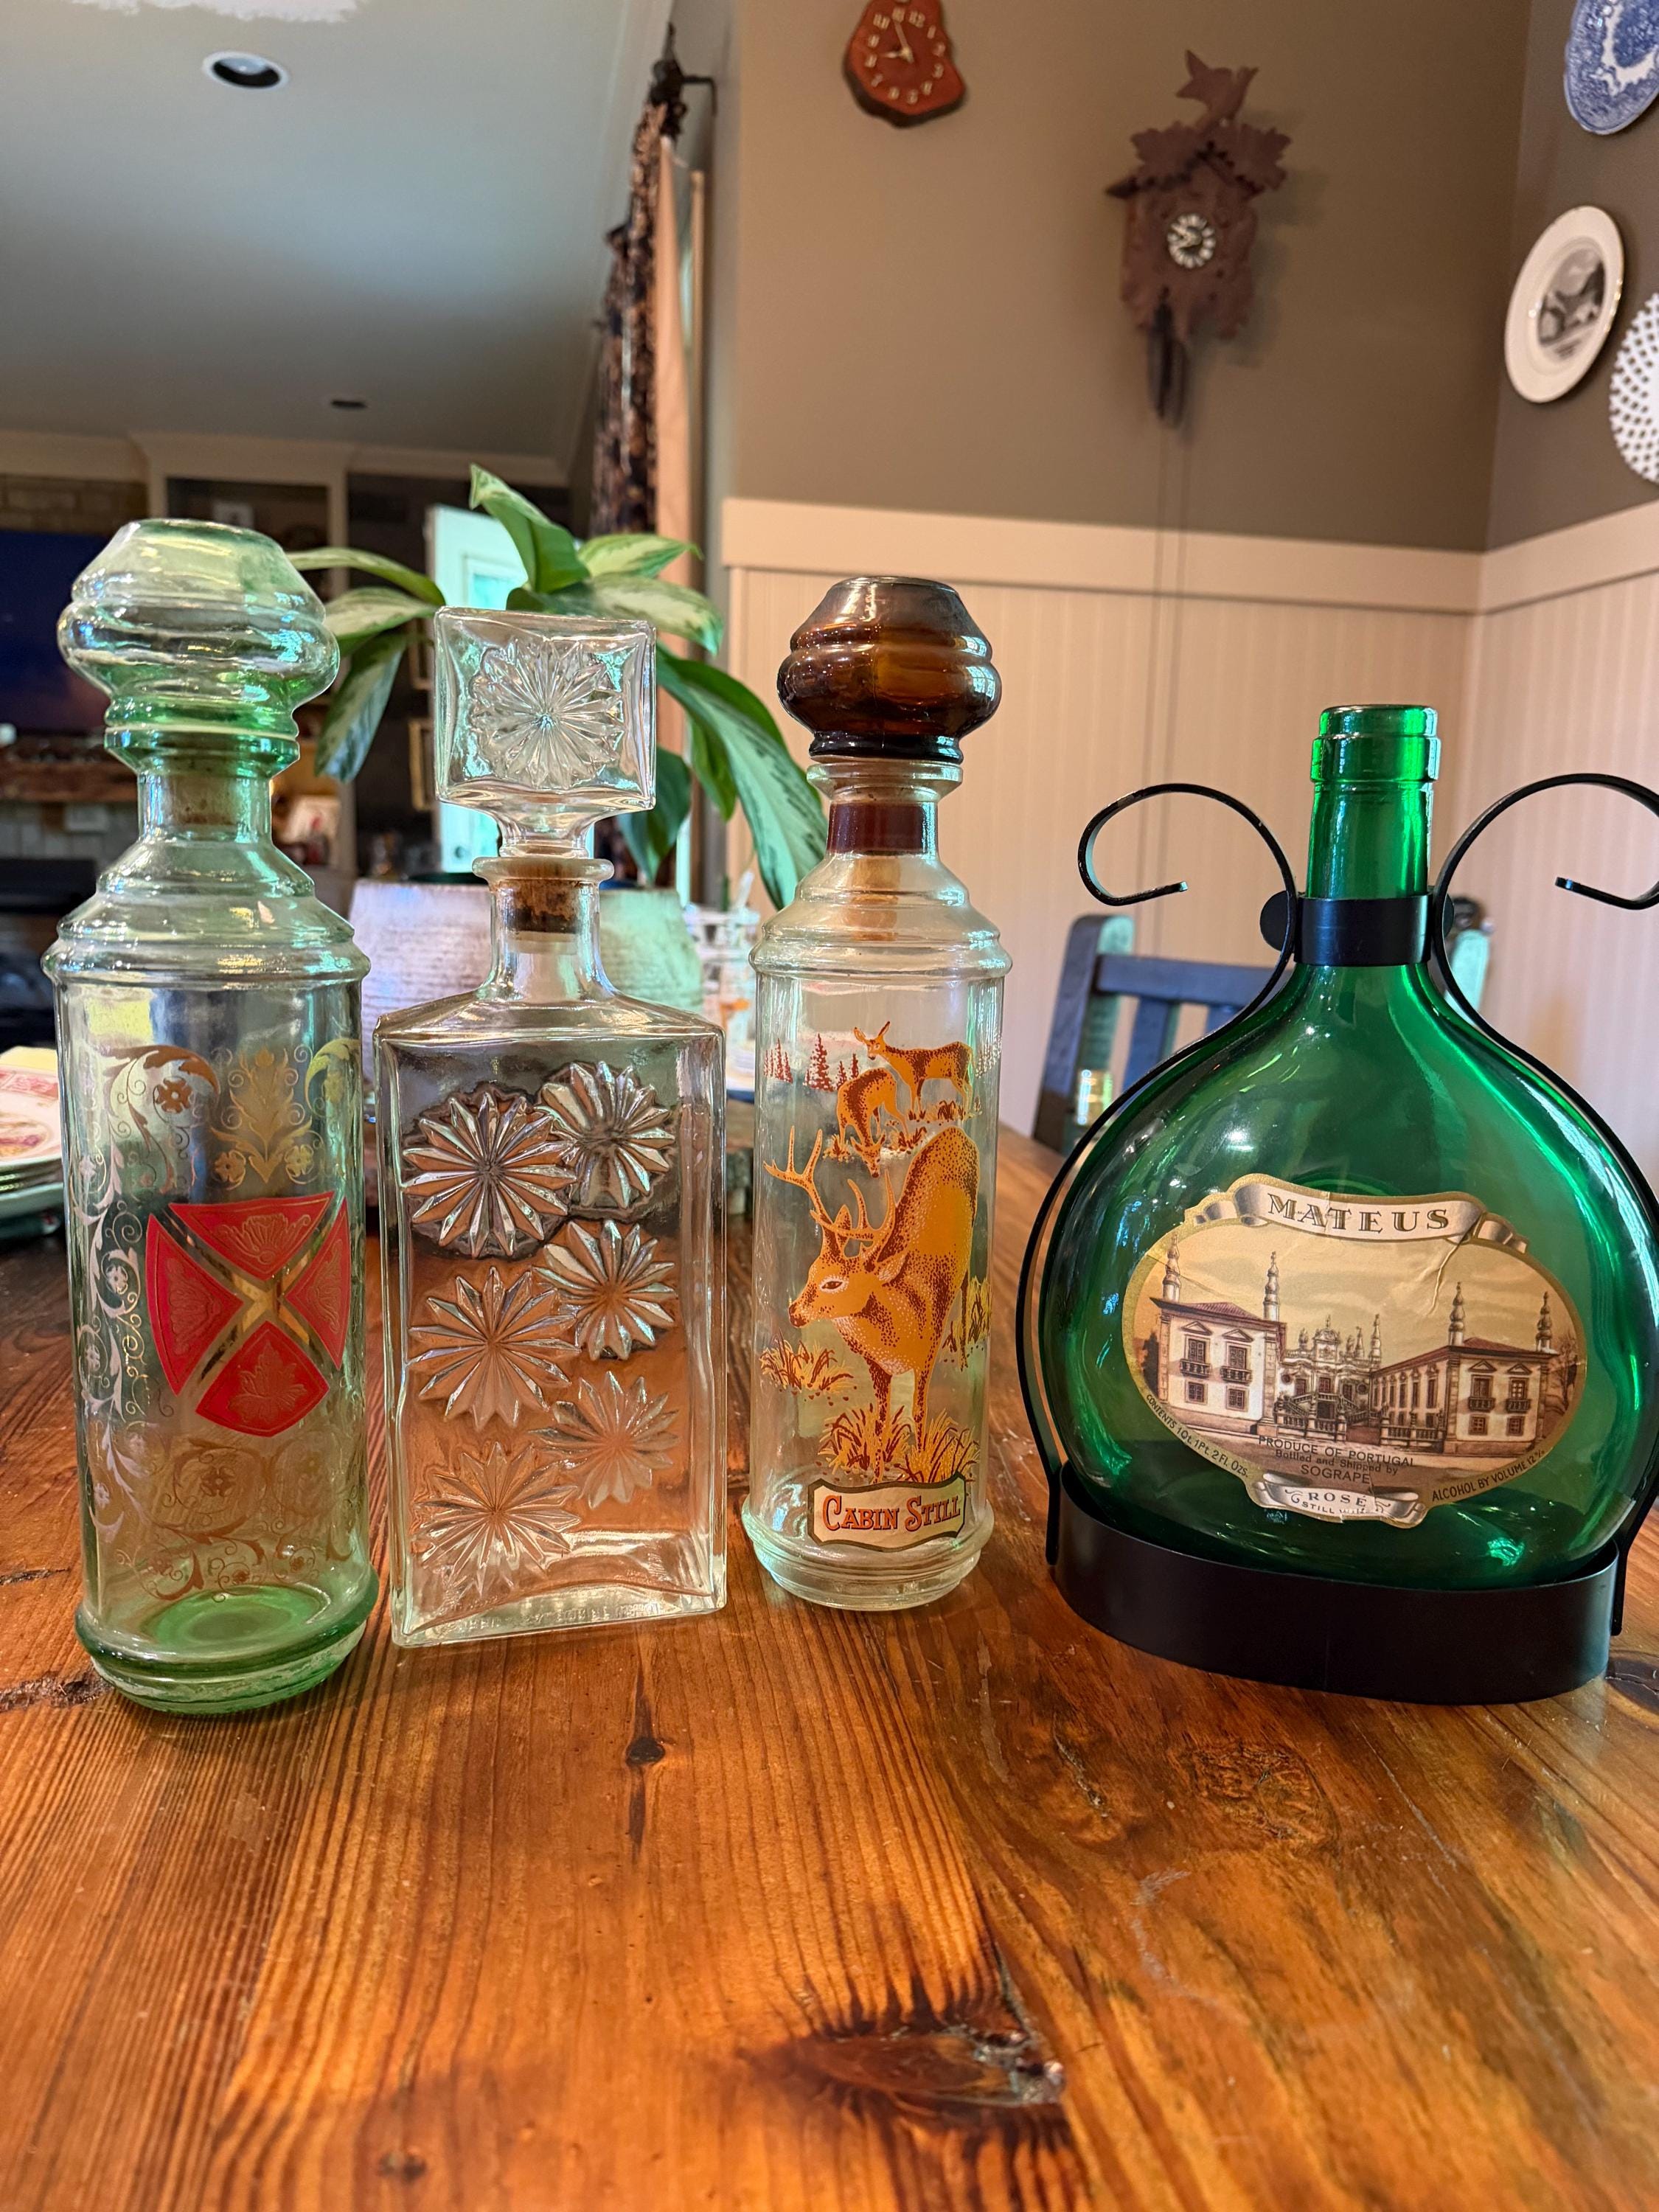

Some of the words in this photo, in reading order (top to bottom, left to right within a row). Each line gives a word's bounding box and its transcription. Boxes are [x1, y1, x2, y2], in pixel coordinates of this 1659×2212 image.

[1267, 1193, 1449, 1234] MATEUS
[1147, 1394, 1177, 1428] CONTENTS
[1259, 1435, 1318, 1455] PRODUCE
[1325, 1447, 1342, 1458] OF
[1349, 1451, 1416, 1467] PORTUGAL
[1275, 1450, 1312, 1462] Bottled
[1316, 1458, 1335, 1466] and
[1340, 1459, 1381, 1472] Shipped
[1386, 1467, 1398, 1475] by
[1301, 1464, 1371, 1484] SOGRAPE
[1432, 1482, 1476, 1501] ALCOHOL
[1478, 1476, 1489, 1489] BY
[1491, 1461, 1528, 1483] VOLUME
[822, 1495, 900, 1531] CABIN
[904, 1495, 961, 1532] STILL
[1301, 1501, 1335, 1514] STILL
[1309, 1492, 1367, 1507] ROSÉ
